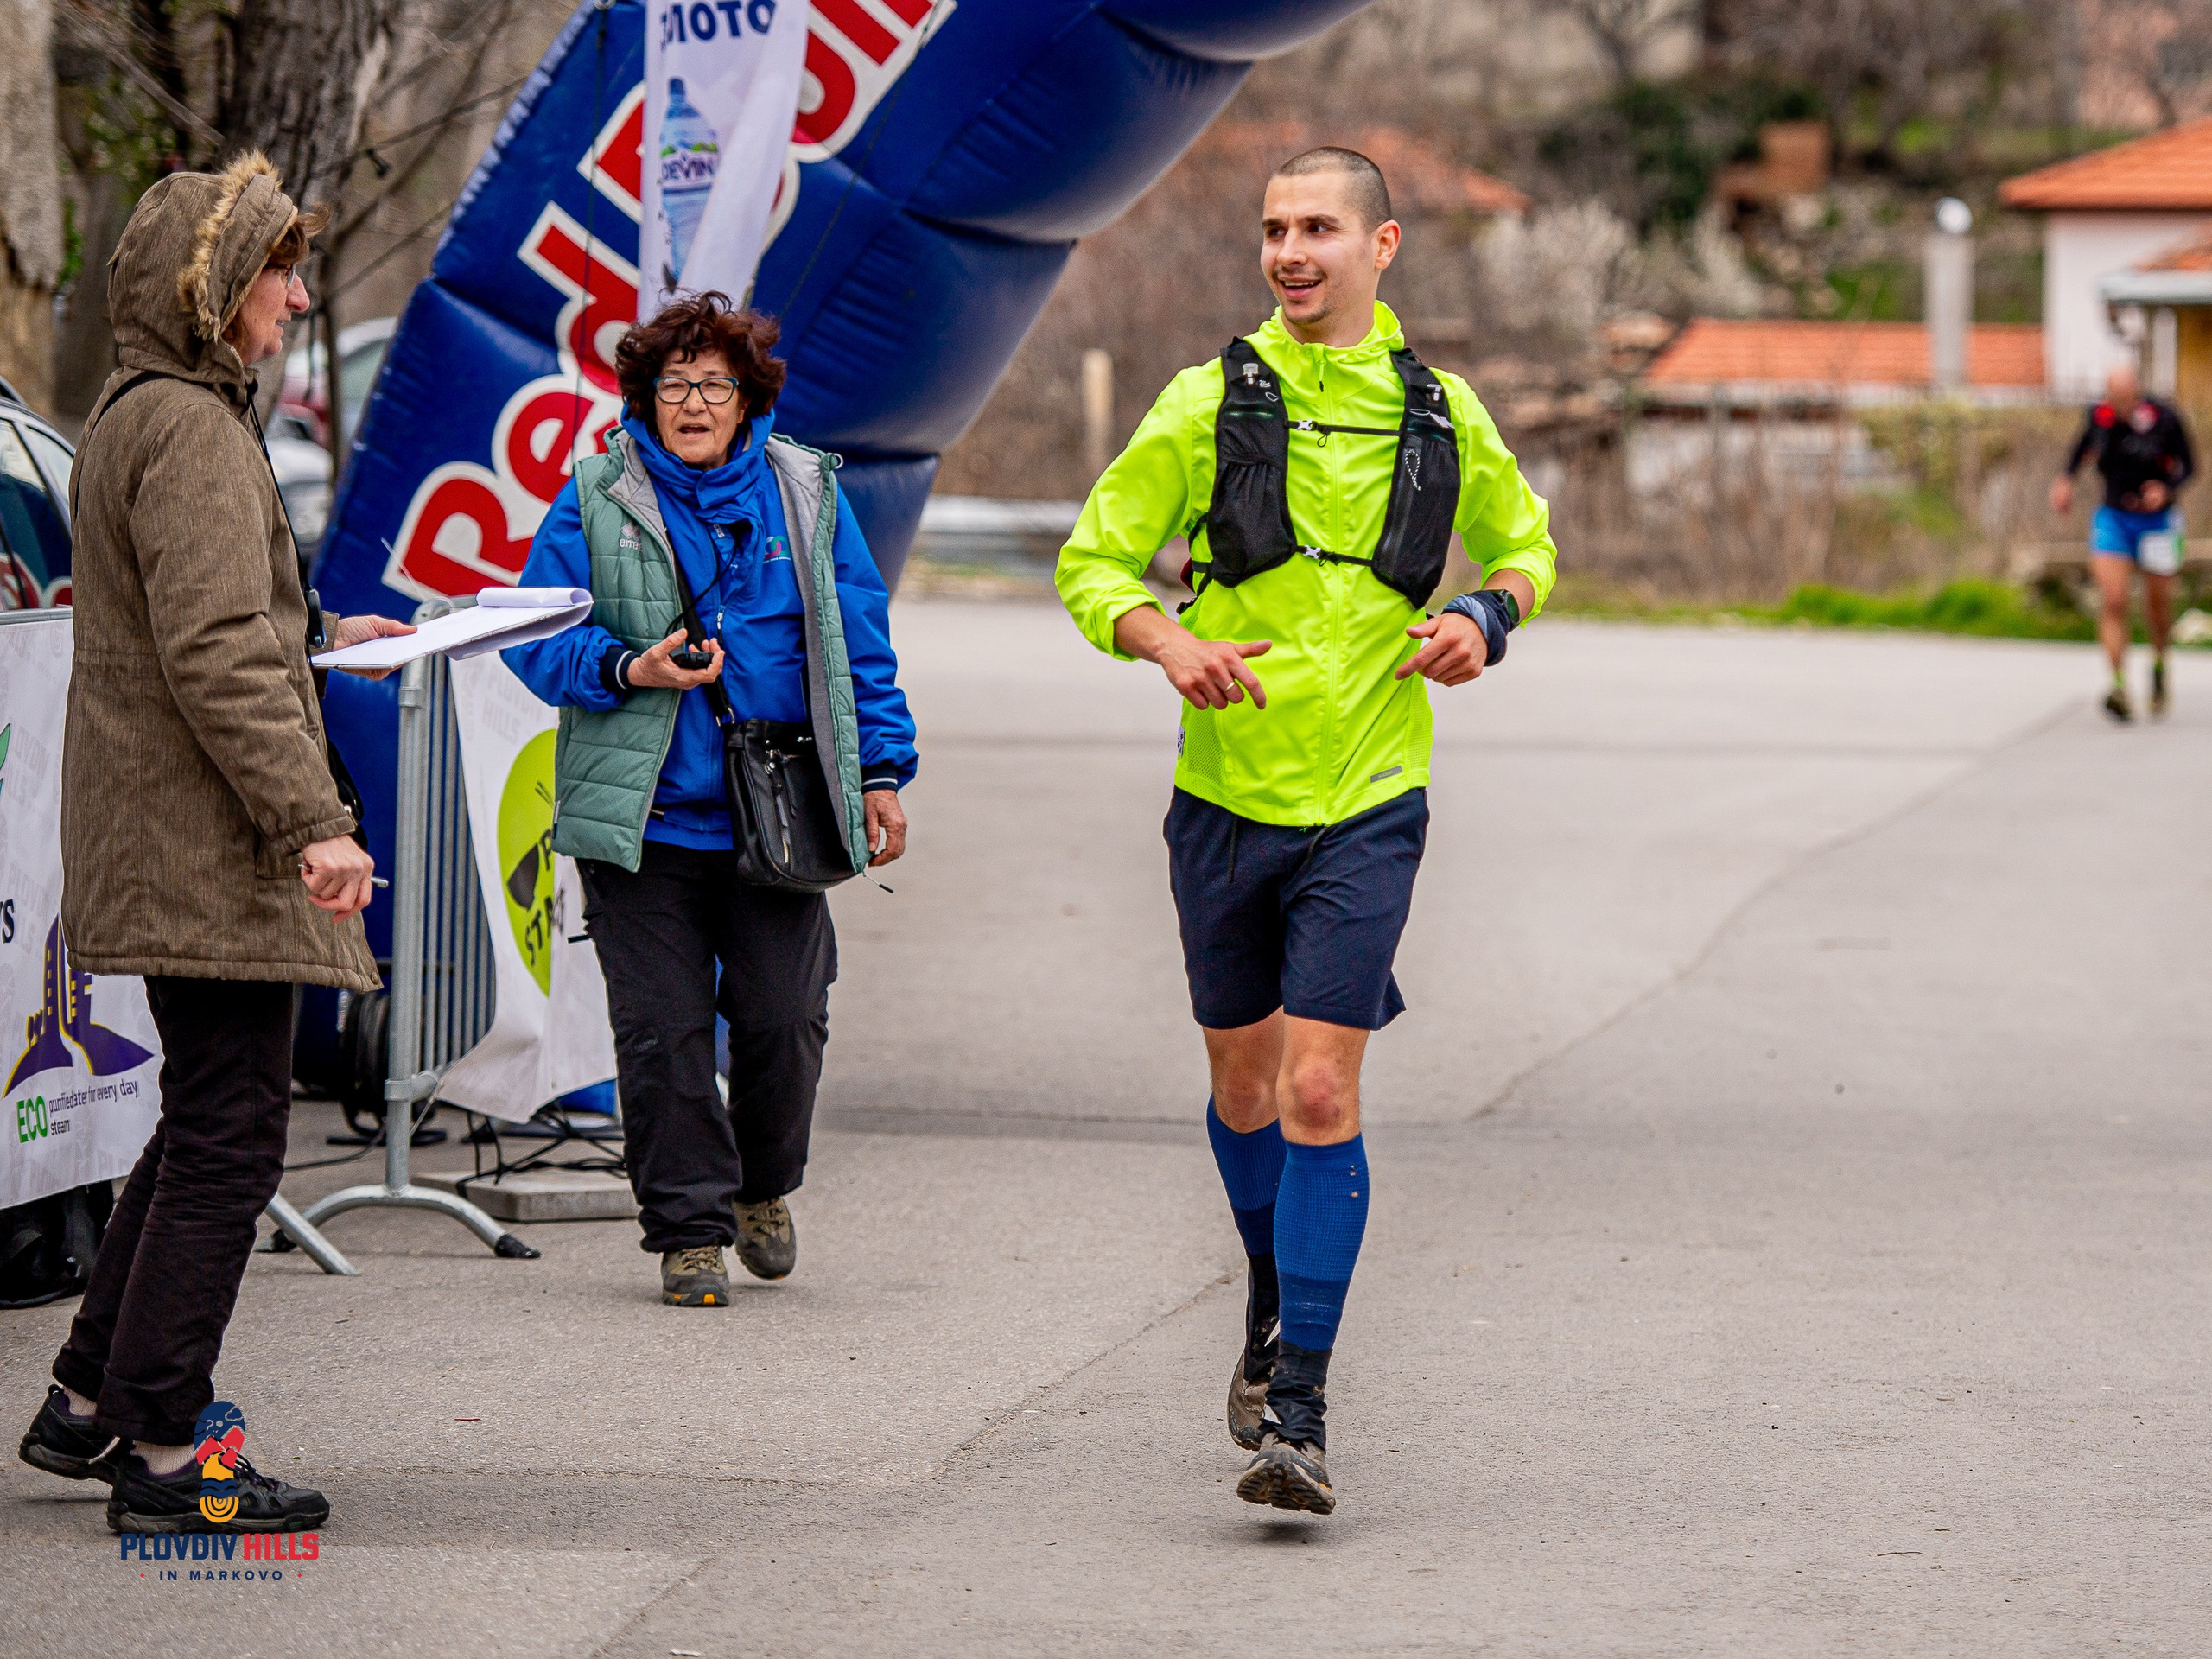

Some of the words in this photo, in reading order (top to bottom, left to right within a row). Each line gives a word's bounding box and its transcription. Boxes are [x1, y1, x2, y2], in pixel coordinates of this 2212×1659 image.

[97, 1084, 118, 1102] every
[119, 1078, 138, 1098] day
[16, 1096, 48, 1143] ECO
[50, 1118, 70, 1135] steam
